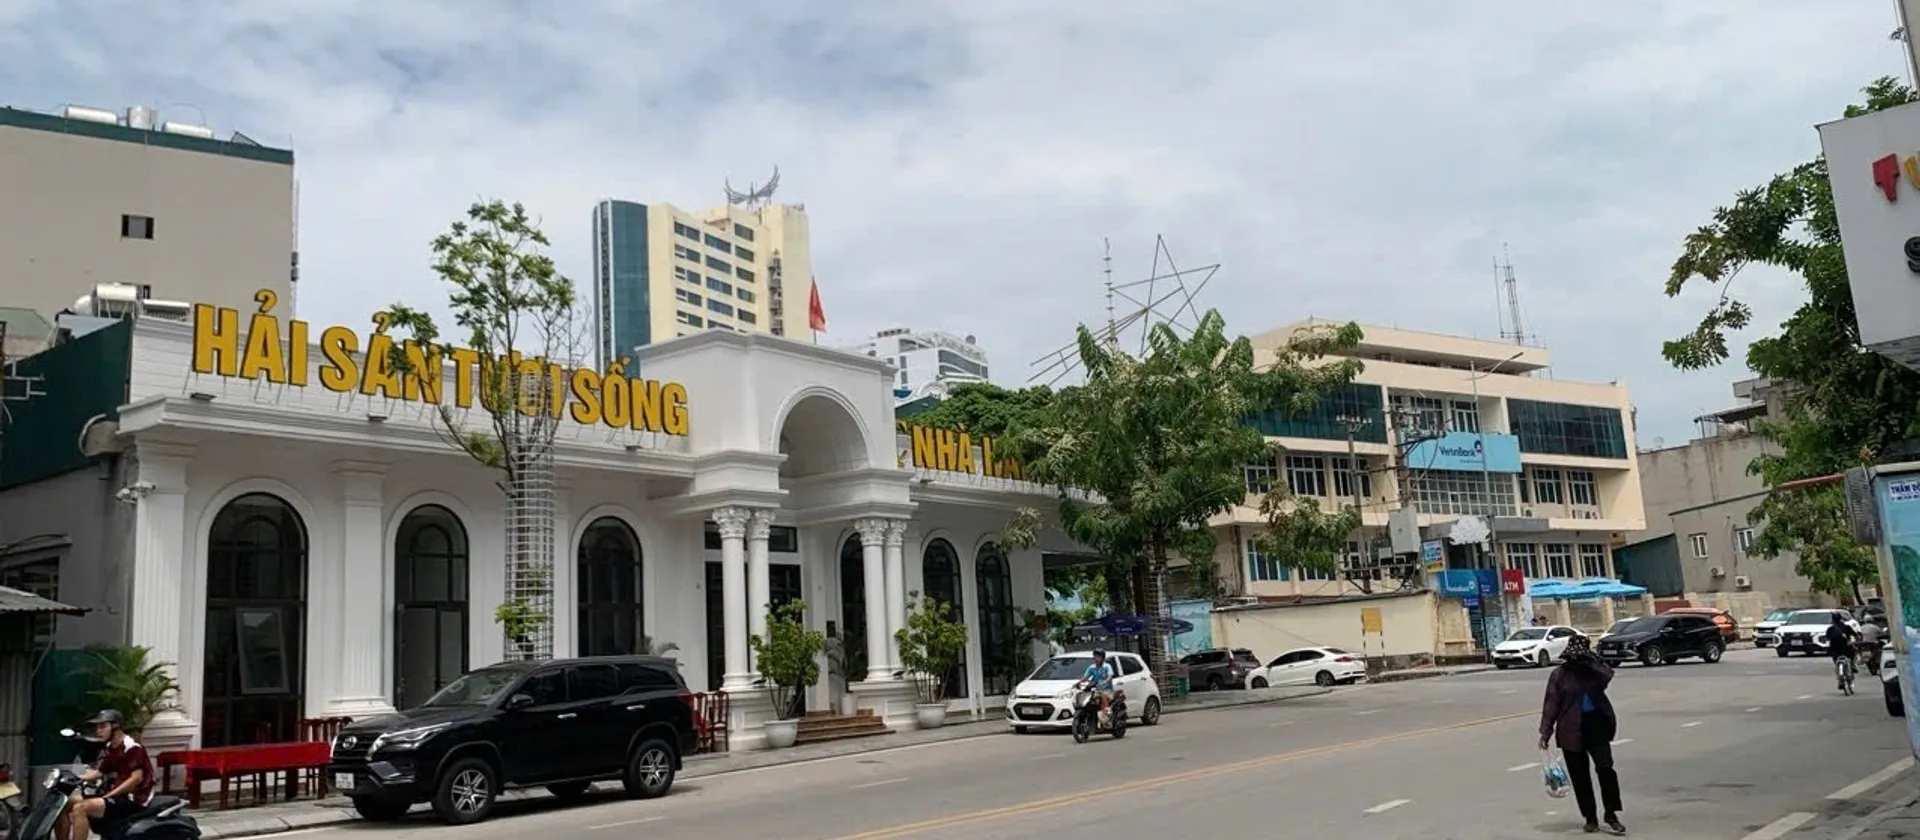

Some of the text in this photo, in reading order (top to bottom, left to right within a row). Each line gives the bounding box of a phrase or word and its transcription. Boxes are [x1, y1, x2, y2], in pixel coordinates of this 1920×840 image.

[193, 289, 309, 387] HẢI
[319, 311, 442, 404] SẢN
[570, 355, 688, 437] SỐNG
[911, 422, 975, 475] NHÀ
[1503, 580, 1520, 592] ATM
